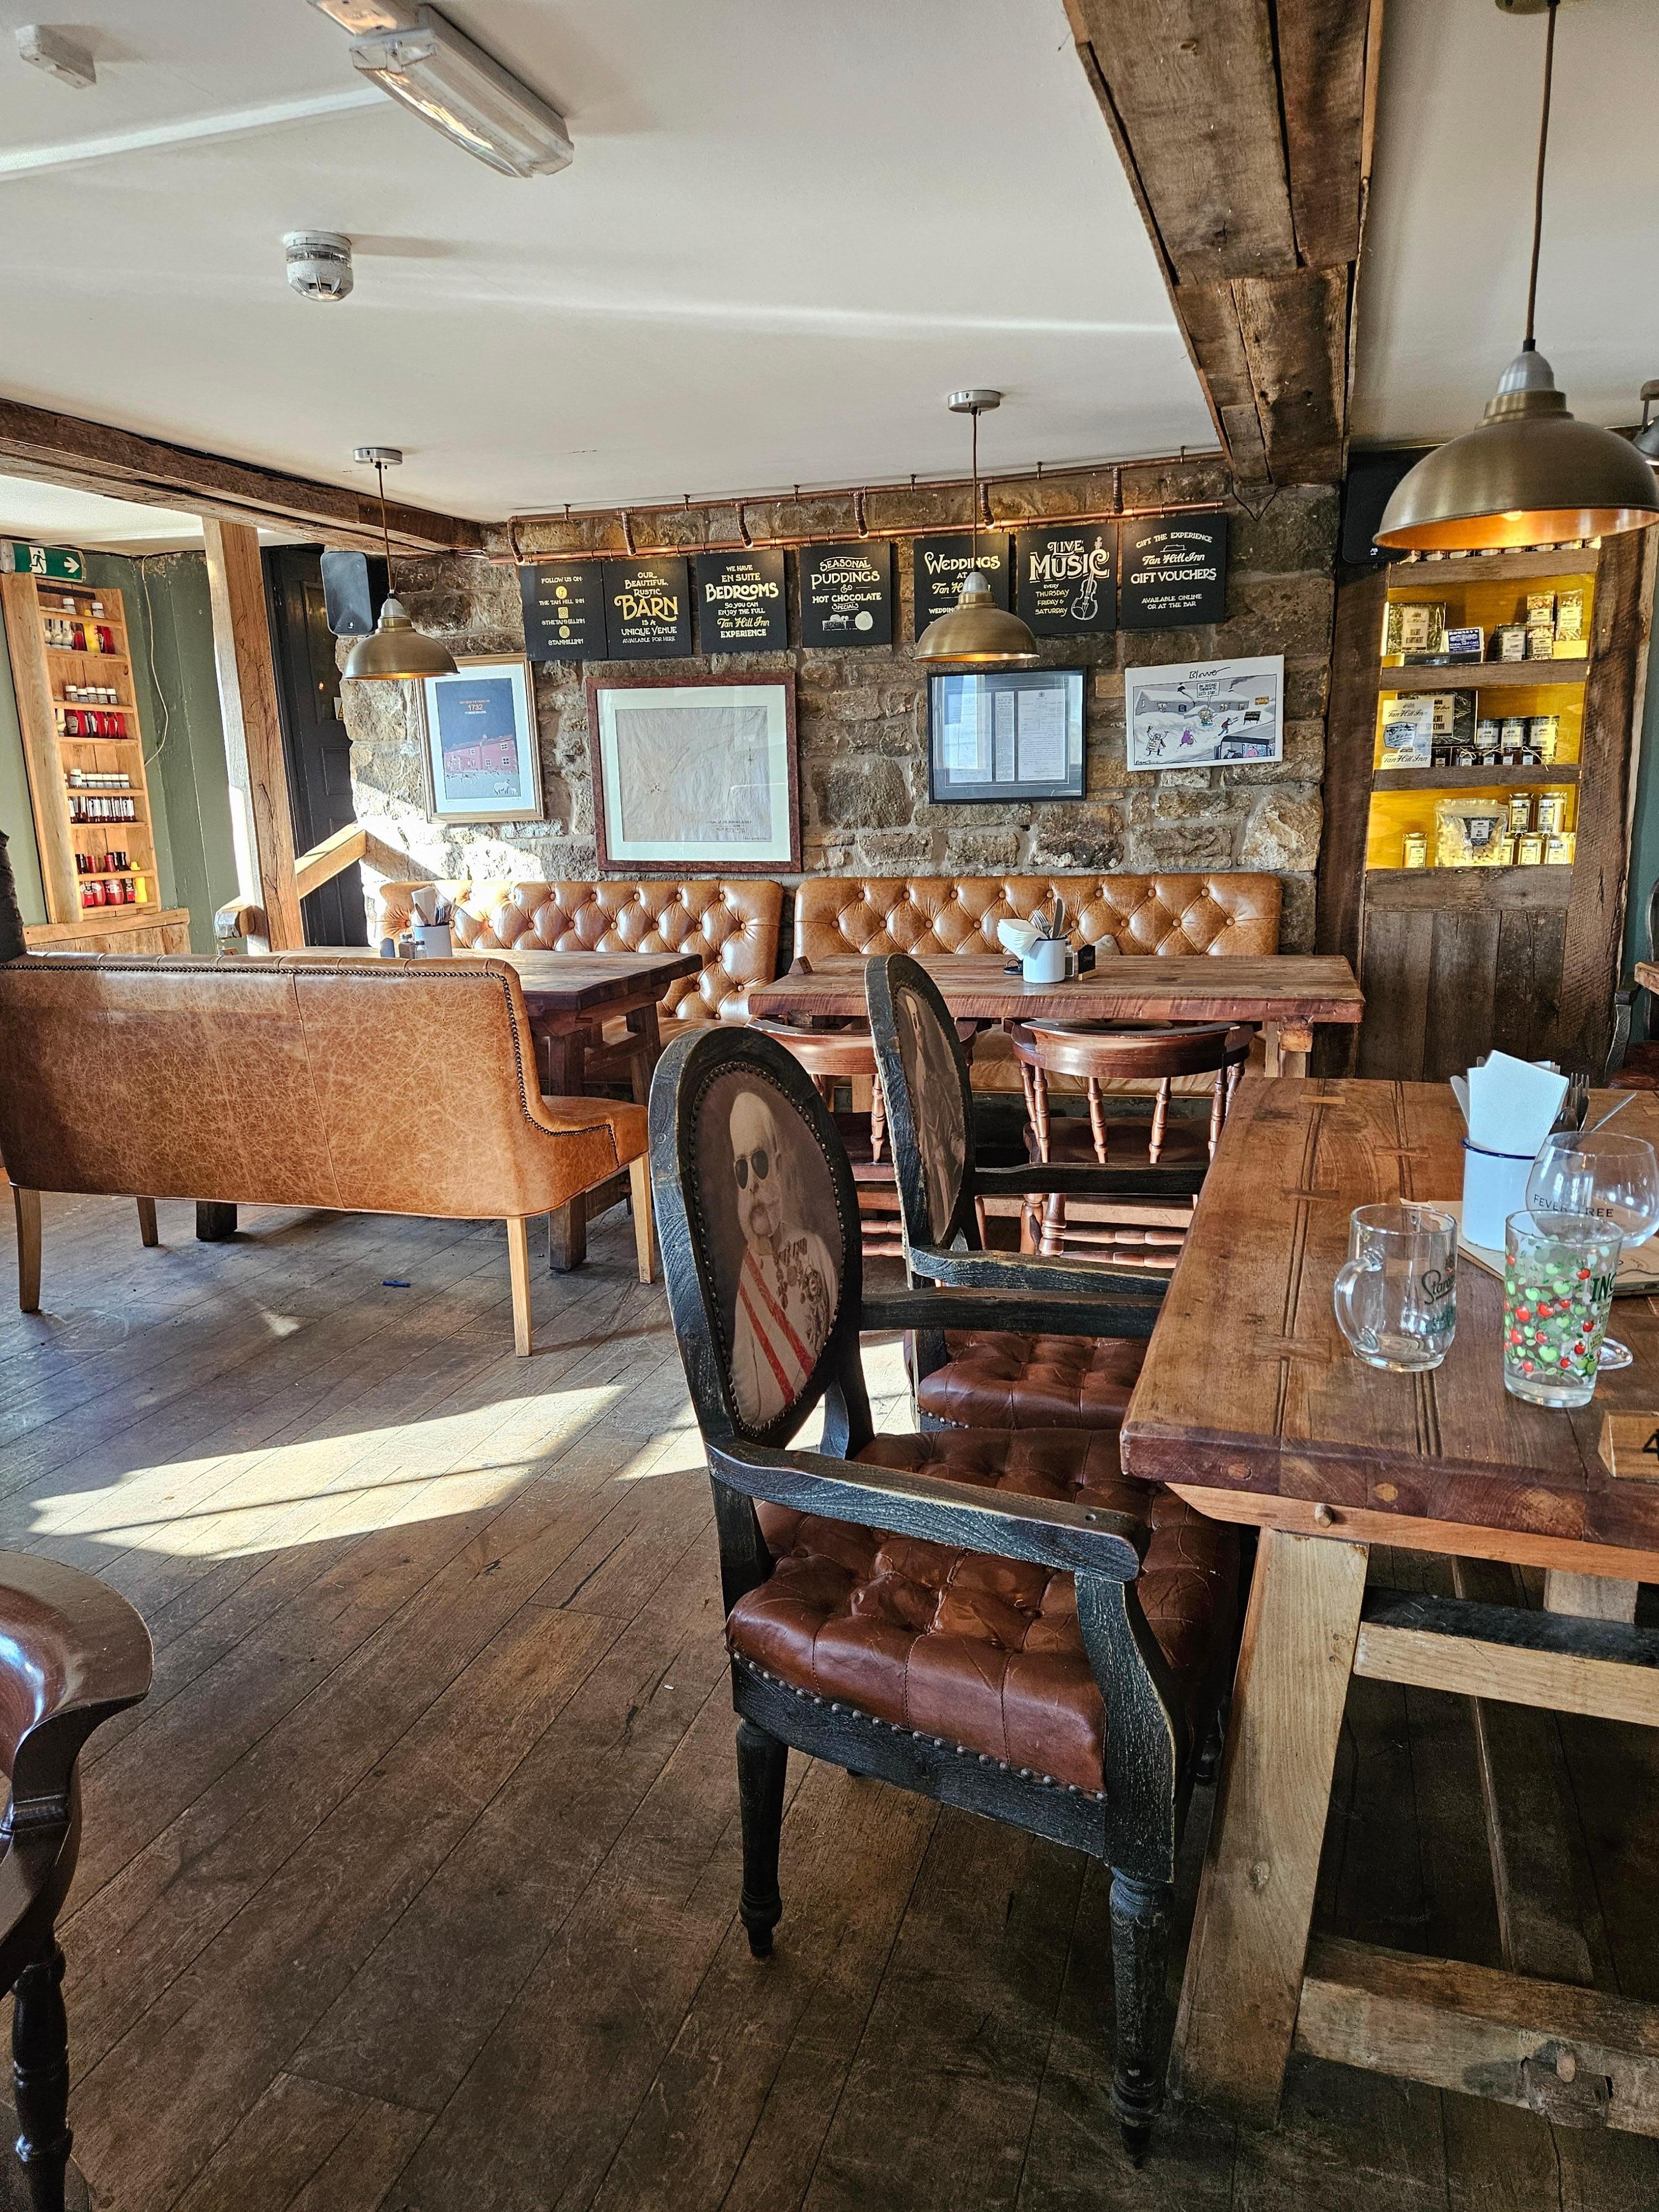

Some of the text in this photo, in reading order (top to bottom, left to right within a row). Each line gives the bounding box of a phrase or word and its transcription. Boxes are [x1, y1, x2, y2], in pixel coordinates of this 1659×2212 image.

[1136, 531, 1213, 549] GIFT THE EXPERIENCE
[1047, 540, 1085, 556] LIVE
[1142, 552, 1205, 566] Tan Hill Inn
[819, 559, 871, 572] SEASONAL
[1029, 549, 1110, 583] MUSIC
[721, 572, 761, 583] EN SUITE
[810, 570, 880, 590] PUDDINGS
[1130, 568, 1217, 584] GIFT VOUCHERS
[633, 588, 662, 599] RUSTIC
[705, 582, 779, 603] BEDROOMS
[840, 583, 853, 593] &
[932, 582, 950, 594] Tan
[1035, 589, 1070, 598] THURSDAY
[812, 592, 883, 604] HOT CHOCOLATE
[1141, 596, 1176, 604] AVAILABLE
[614, 594, 679, 622] BARN
[831, 602, 859, 611] SPECIALS
[1035, 608, 1068, 617] SATURDAY
[717, 615, 770, 629] Tan Hill Inn
[620, 625, 677, 637] UNIQUE VENUE
[720, 628, 767, 639] EXPERIENCE
[1400, 709, 1414, 717] Hill
[1396, 754, 1412, 763] Hill
[1412, 754, 1428, 762] Inn
